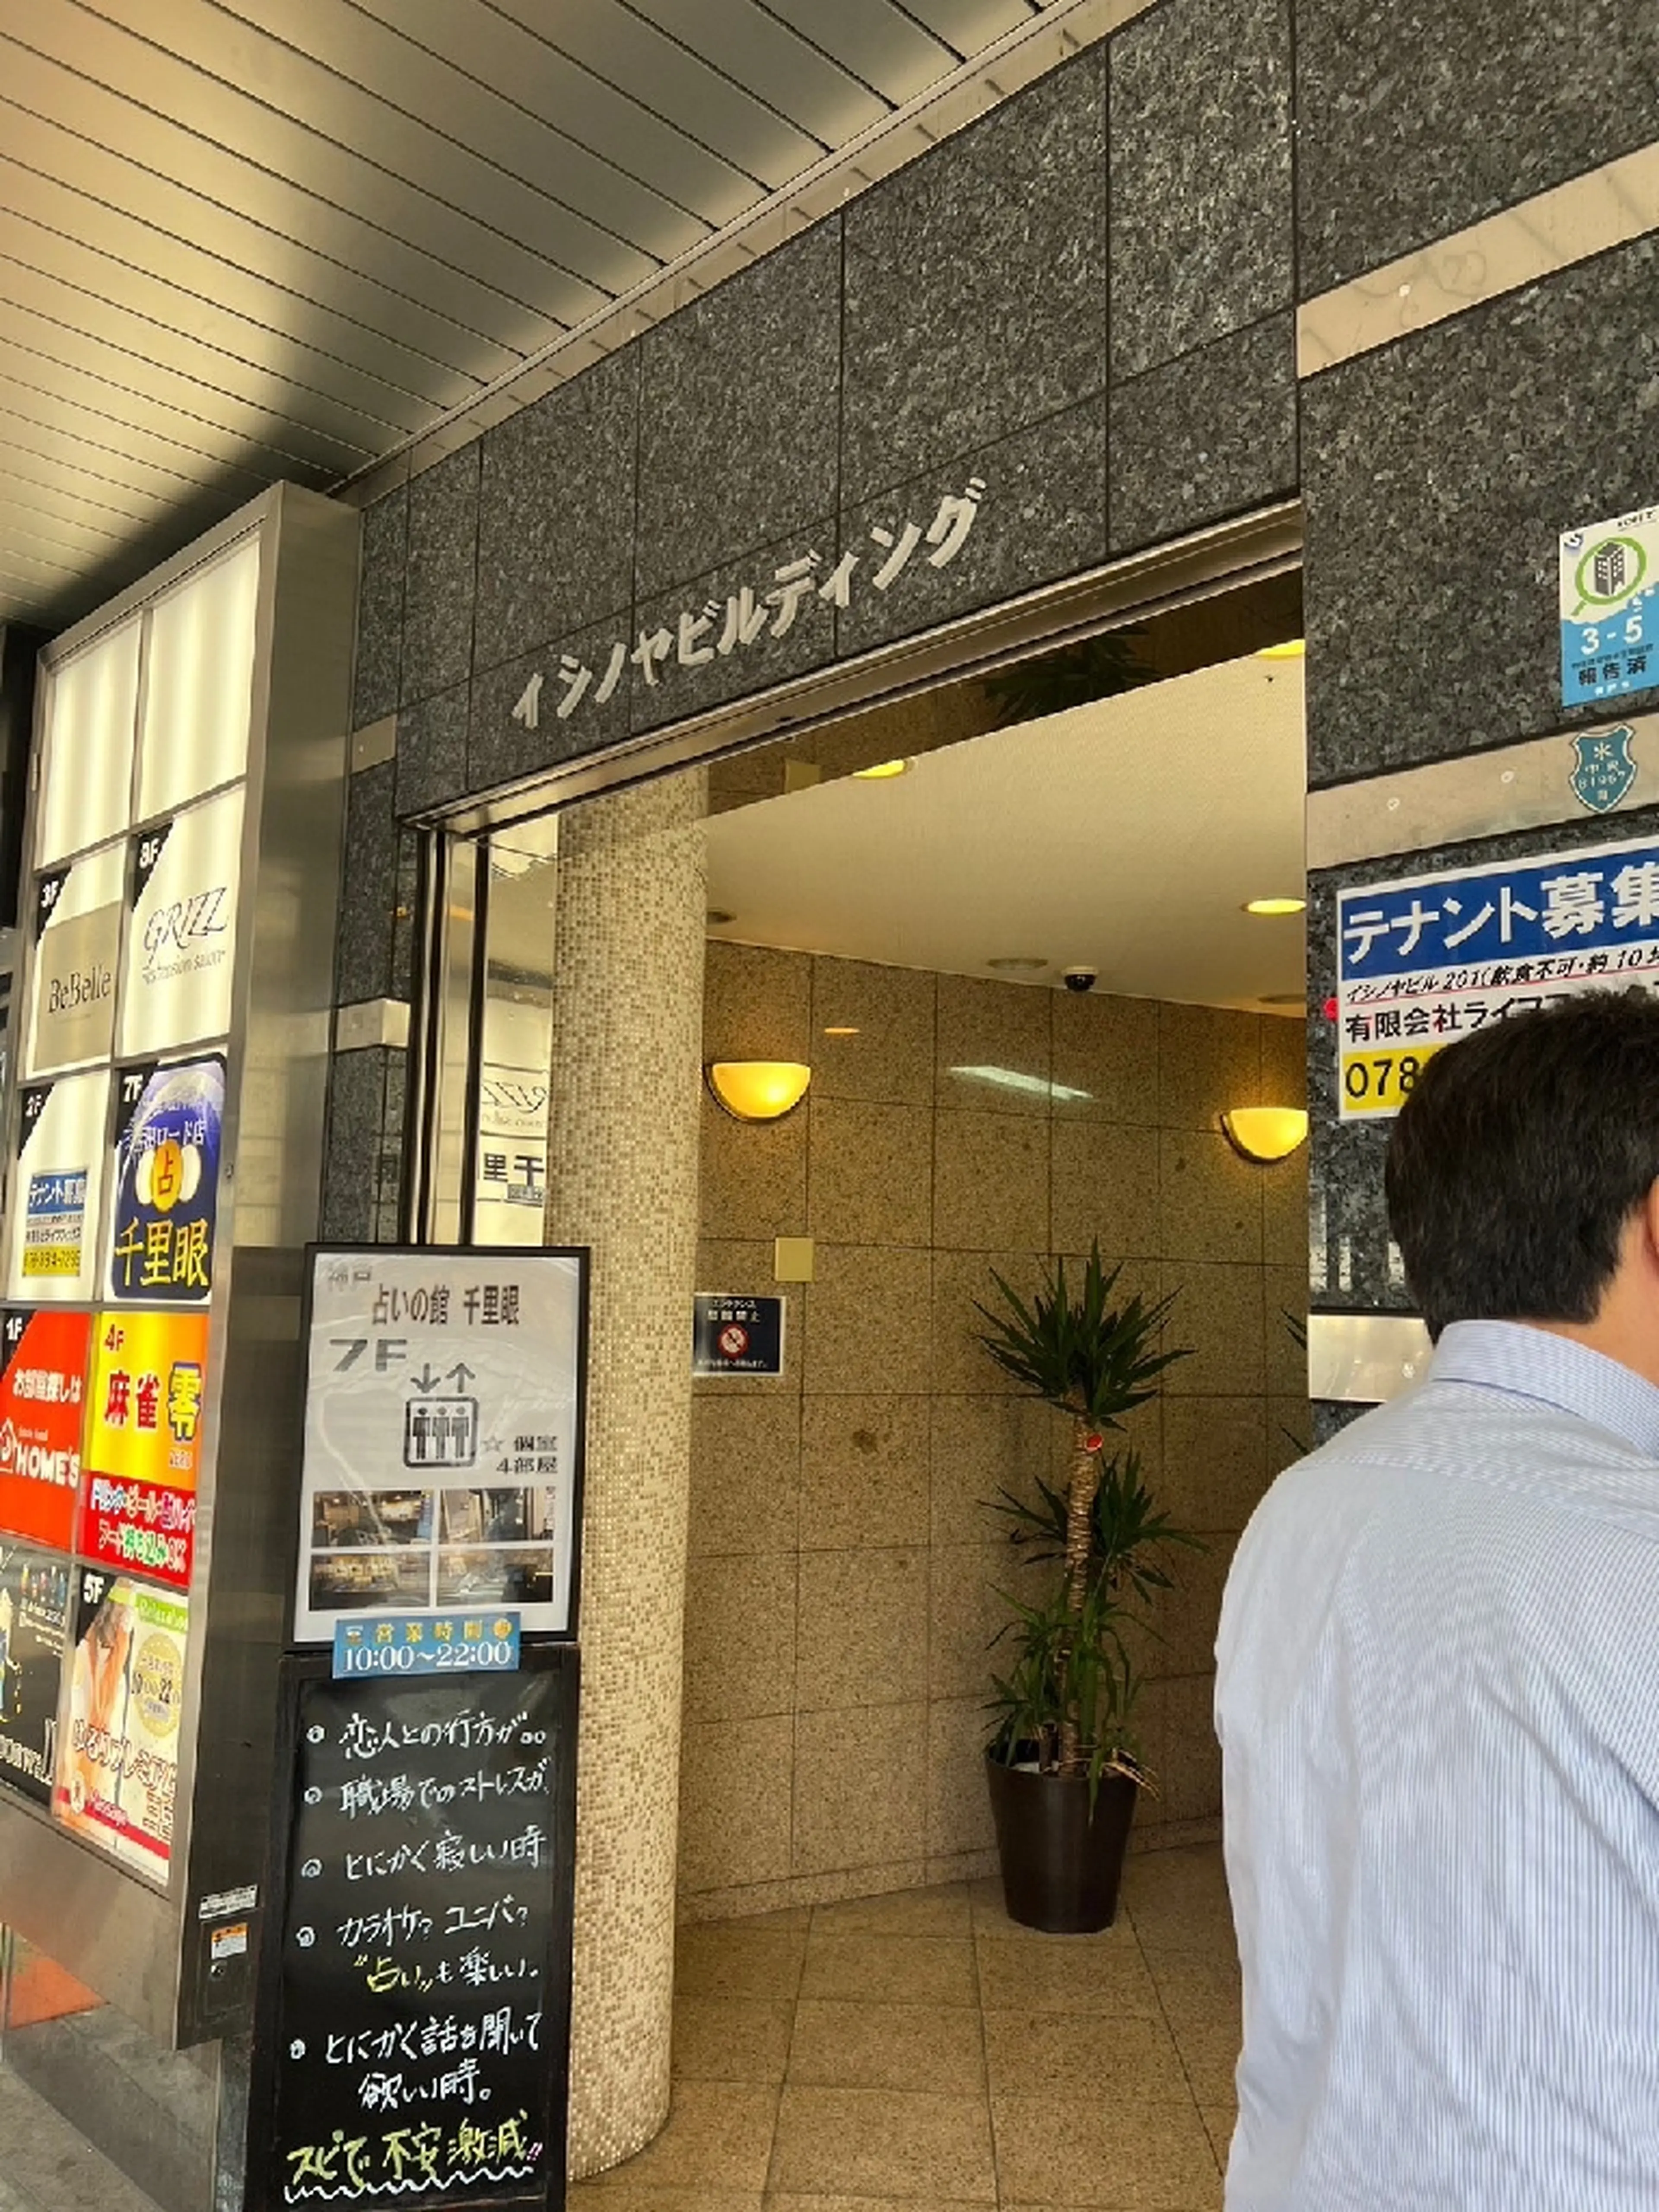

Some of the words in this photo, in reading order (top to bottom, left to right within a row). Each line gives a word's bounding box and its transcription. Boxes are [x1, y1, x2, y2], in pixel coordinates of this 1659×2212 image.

[511, 477, 988, 729] イシノヤビルディング
[1343, 861, 1659, 965] テナント募集
[48, 963, 111, 1014] BeBelle
[1347, 973, 1440, 1002] イシノヤビル
[115, 1217, 209, 1287] 千里眼
[372, 1284, 450, 1325] 占いの館
[464, 1285, 519, 1325] 千里眼
[105, 1323, 124, 1351] 4F
[329, 1339, 408, 1372] 7F
[105, 1370, 160, 1429] 麻雀
[16, 1438, 80, 1489] HOME'S
[83, 1574, 105, 1603] 5F
[324, 2005, 543, 2064] とにかく話を聞いて
